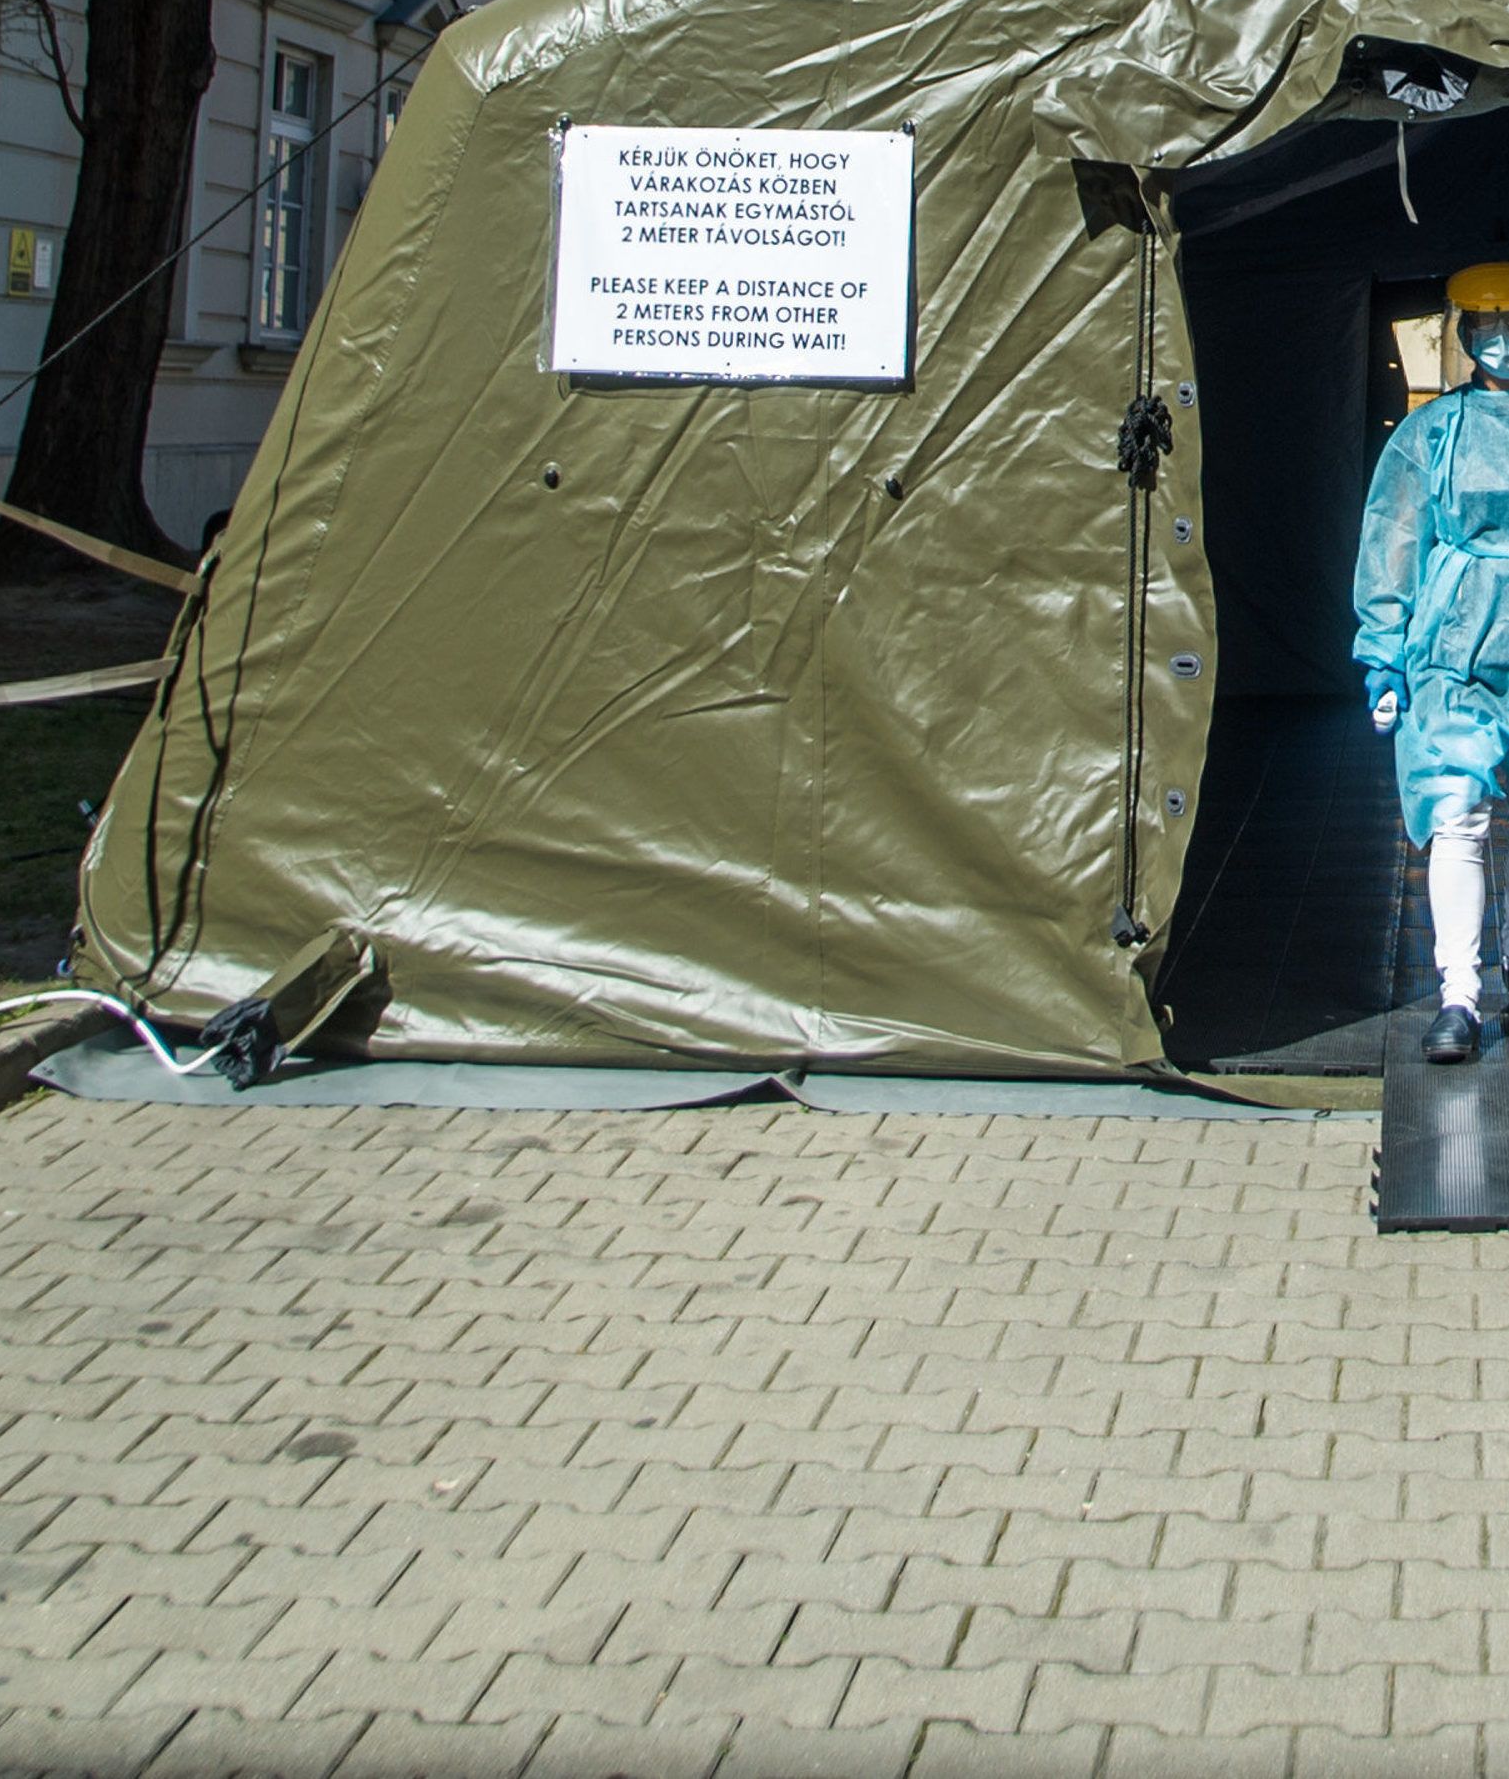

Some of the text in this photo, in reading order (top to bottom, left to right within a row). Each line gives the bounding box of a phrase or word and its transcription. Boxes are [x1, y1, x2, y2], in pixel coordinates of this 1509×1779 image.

[619, 145, 688, 167] KÉRJÜK
[789, 152, 850, 170] HOGY
[630, 171, 836, 195] VÁRAKOZÁS KÖZBEN
[615, 199, 856, 222] TARTSANAK EGYMÁSTÓL
[621, 222, 846, 247] 2 MÉTER TÁVOLSÁGOT!
[590, 276, 868, 299] PLEASE KEEP A DISTANCE OF
[616, 302, 838, 324] 2 METERS FROM OTHER
[613, 328, 846, 350] PERSONS DURING WAIT!
